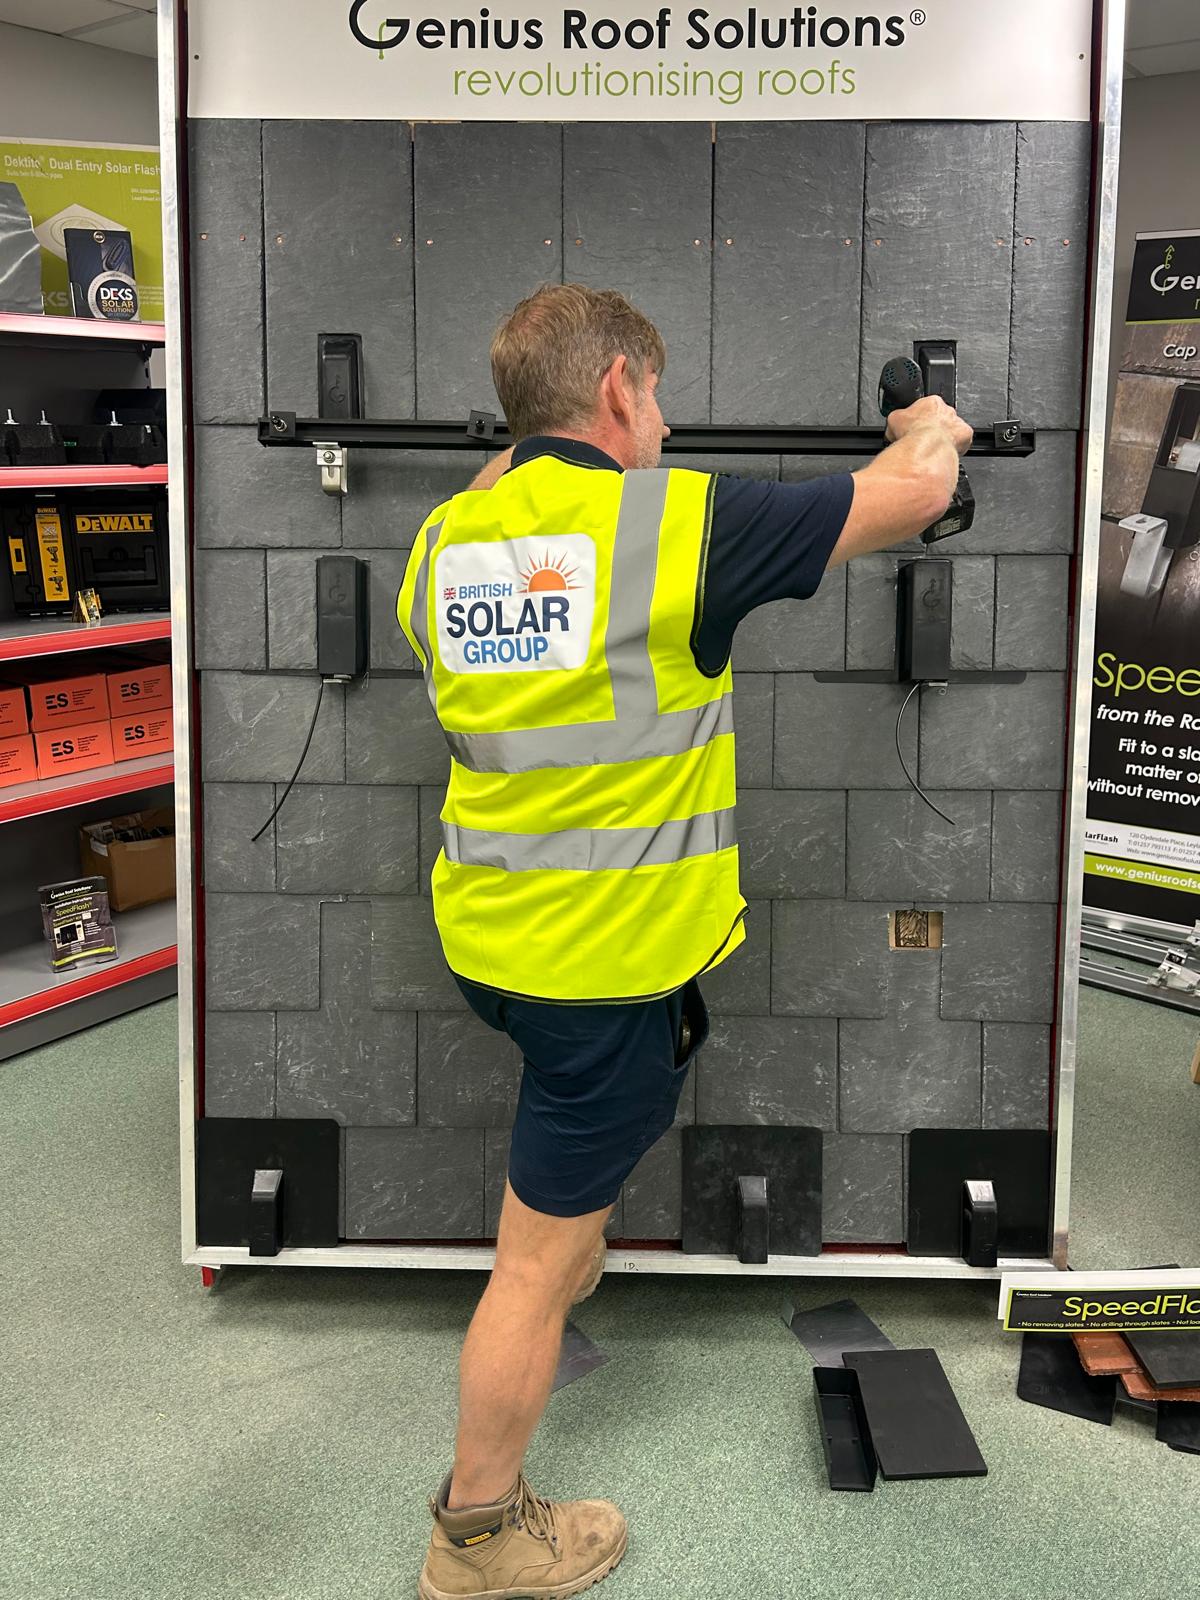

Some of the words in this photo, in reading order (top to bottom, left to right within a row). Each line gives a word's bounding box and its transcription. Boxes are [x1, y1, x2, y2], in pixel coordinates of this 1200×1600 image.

[349, 0, 544, 50] Genius
[563, 8, 672, 50] Roof
[453, 61, 743, 104] revolutionising
[758, 59, 856, 96] roofs
[49, 158, 73, 170] Dual
[76, 160, 103, 174] Entry
[106, 162, 132, 174] Solar
[100, 287, 133, 301] DEKS
[101, 300, 134, 308] SOLAR
[1163, 344, 1197, 360] Cap
[458, 583, 513, 600] BRITISH
[446, 596, 570, 639] SOLAR
[463, 636, 549, 665] GROUP
[120, 682, 140, 698] ES
[45, 693, 69, 710] ES
[1096, 704, 1139, 723] from
[1143, 709, 1175, 727] the
[124, 725, 145, 741] ES
[51, 740, 74, 757] ES
[1119, 738, 1137, 753] Fit
[1140, 740, 1157, 755] to
[1161, 746, 1174, 758] a
[1125, 763, 1183, 781] matter
[1086, 778, 1143, 797] without
[1145, 788, 1200, 806] remov
[1101, 1320, 1123, 1328] drilling
